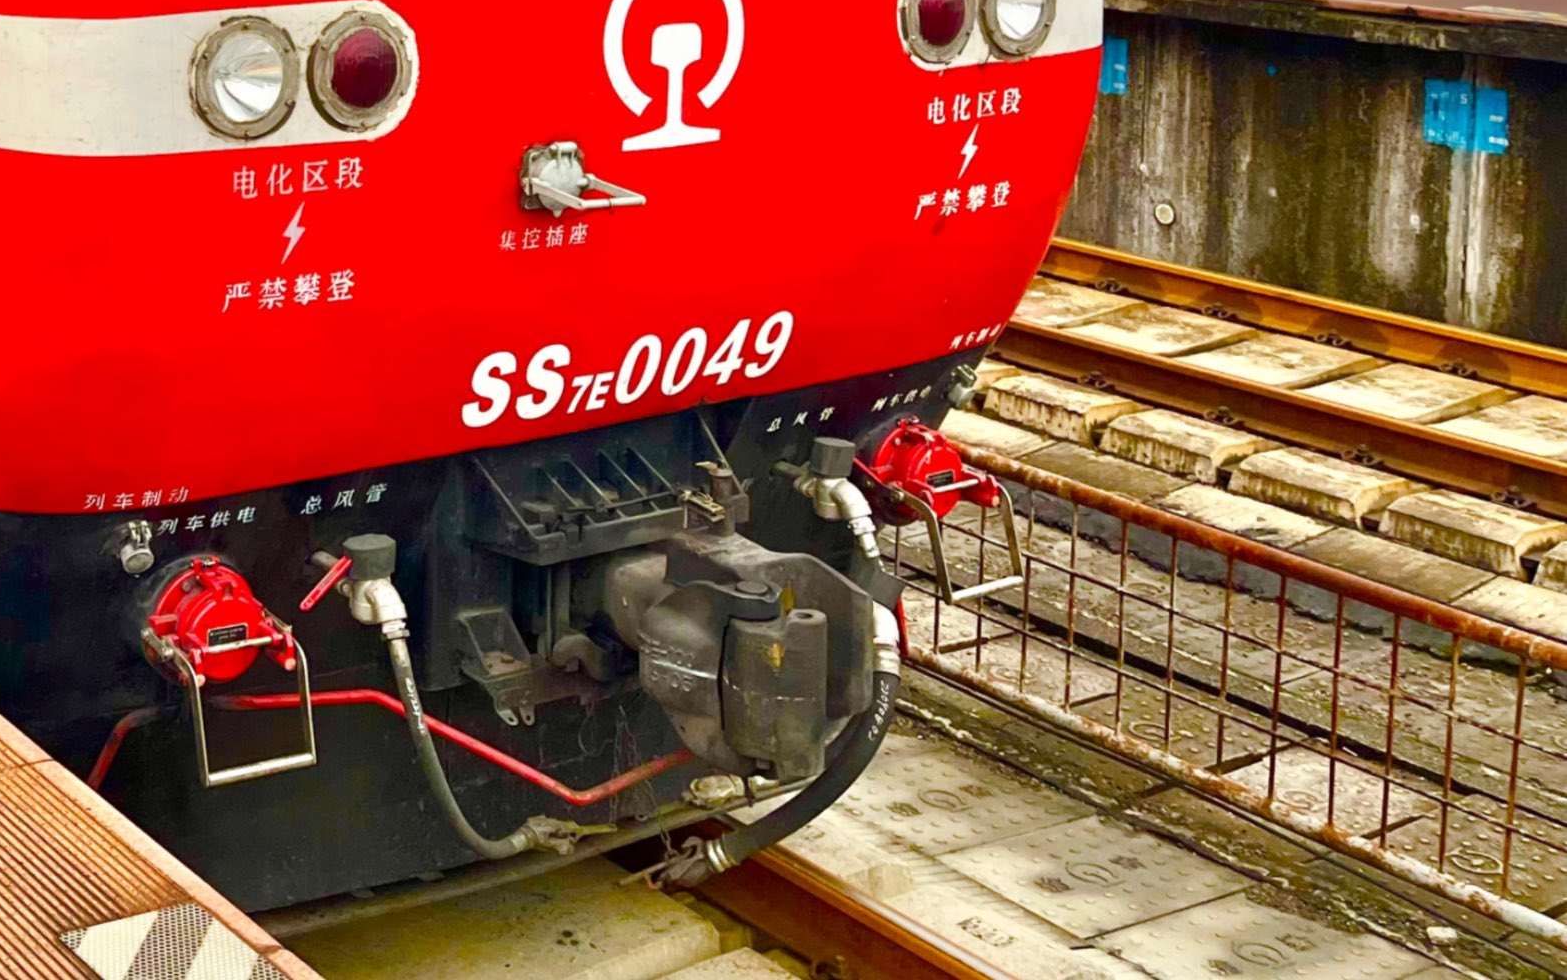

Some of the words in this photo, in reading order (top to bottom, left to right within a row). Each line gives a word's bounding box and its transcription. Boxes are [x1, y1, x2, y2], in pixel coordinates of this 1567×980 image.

[927, 87, 1022, 125] 电化区段
[233, 157, 364, 200] 电化区段
[914, 180, 1011, 221] 严禁攀登
[499, 222, 589, 252] 集控插座
[222, 269, 355, 313] 严禁攀登
[83, 486, 189, 510] 列车制动
[300, 483, 388, 516] 总风管
[157, 506, 257, 536] 列车供电
